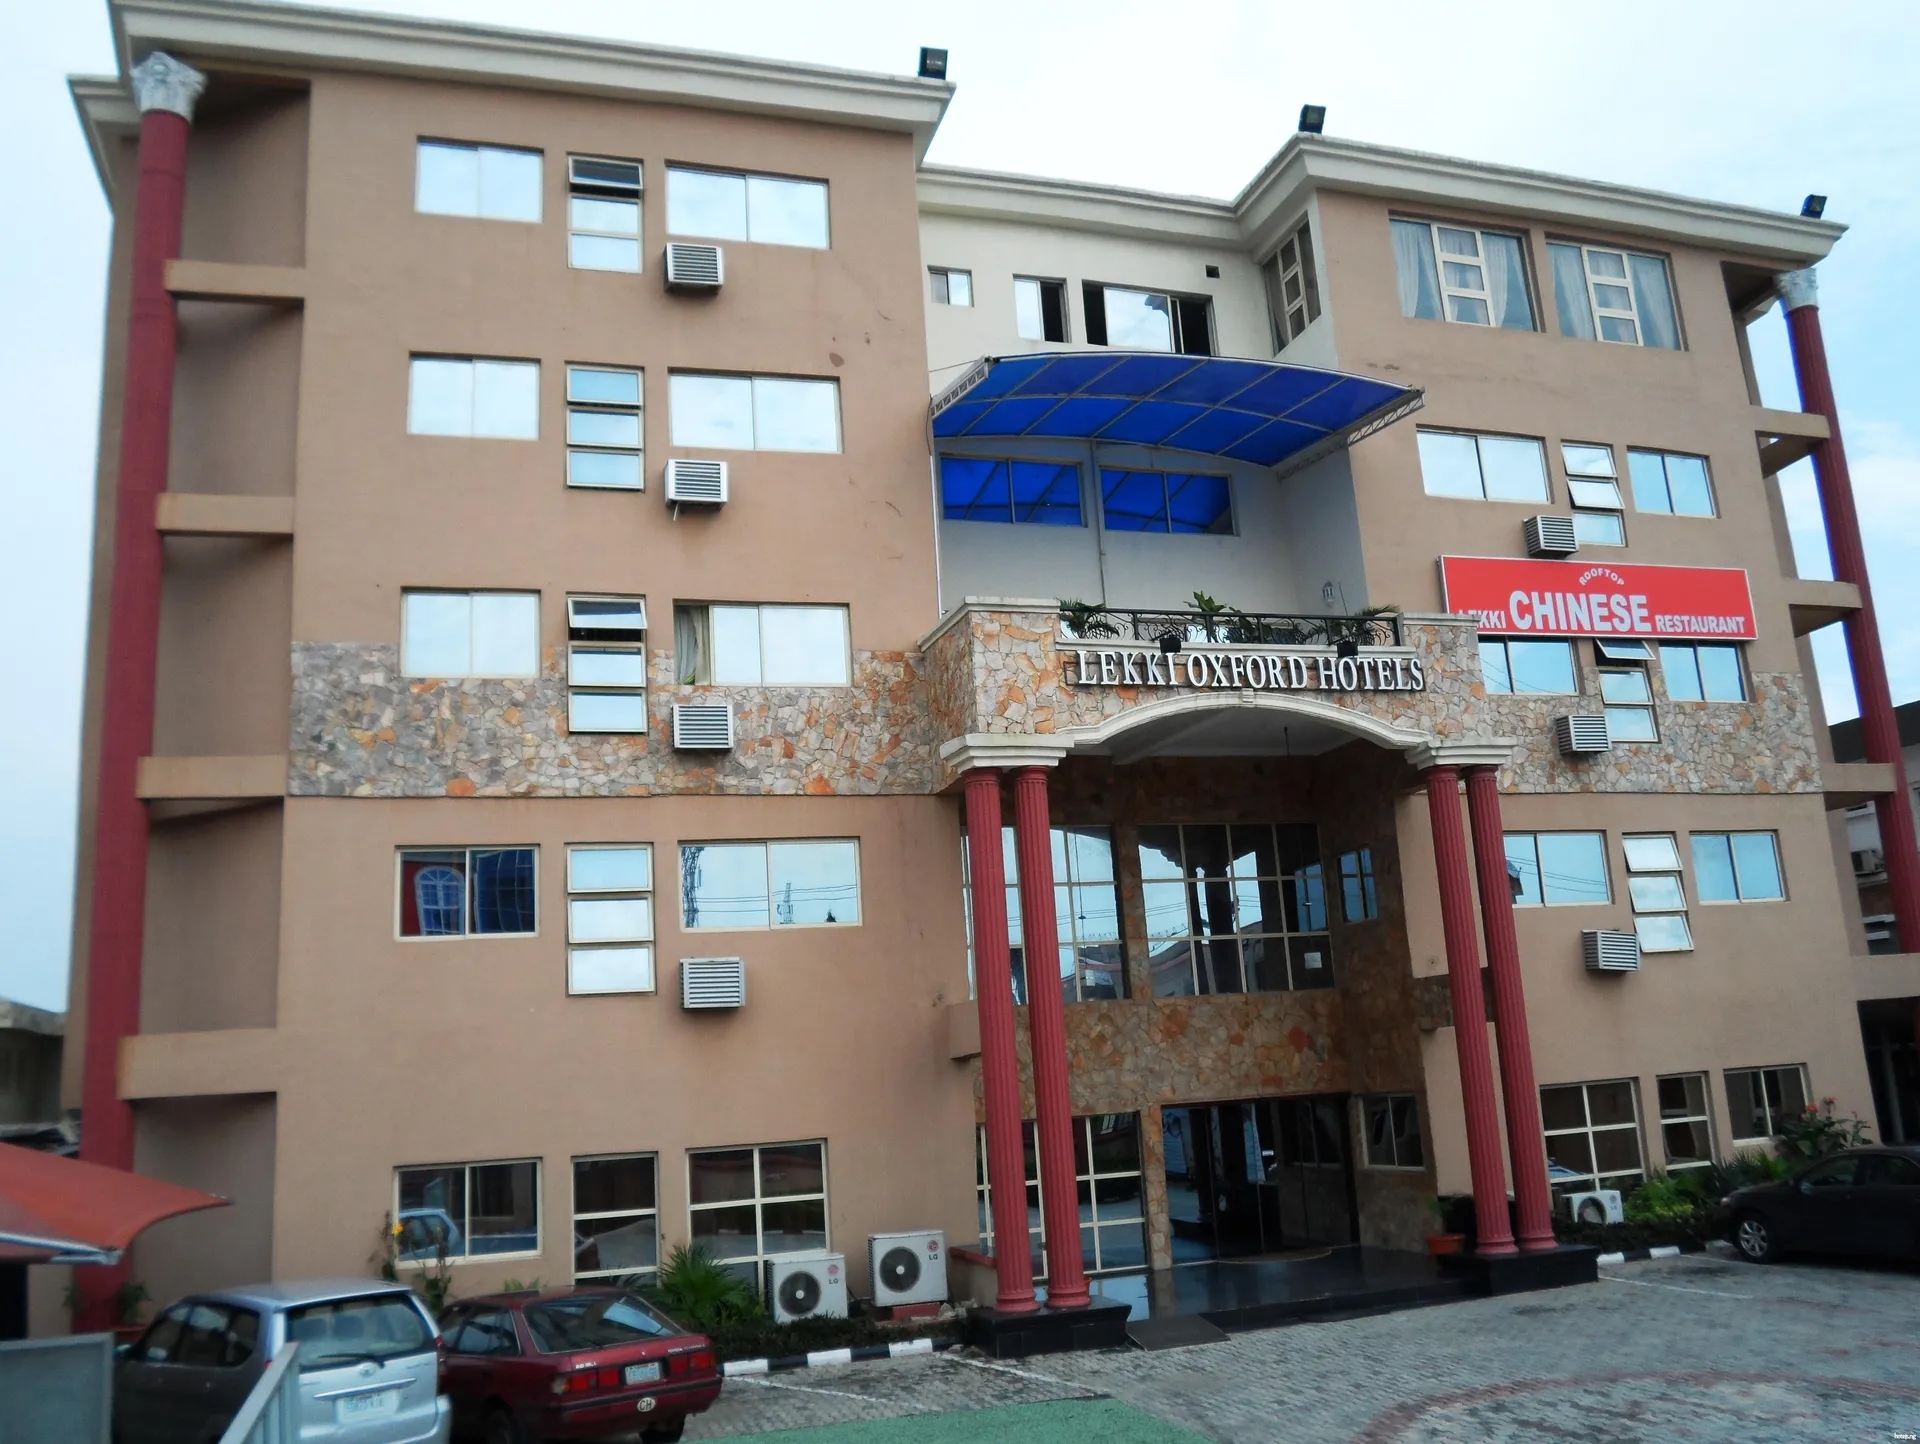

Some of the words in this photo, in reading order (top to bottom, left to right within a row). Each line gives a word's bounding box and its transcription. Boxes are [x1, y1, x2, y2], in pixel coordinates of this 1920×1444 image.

[1579, 568, 1625, 586] ROOFTOP
[1459, 609, 1507, 629] KKI
[1509, 590, 1652, 633] CHINESE
[1655, 614, 1746, 634] RESTAURANT
[1076, 650, 1180, 686] LEKKI
[1187, 653, 1309, 690] OXFORD
[1319, 656, 1425, 691] HOTELS
[639, 1401, 653, 1411] CH
